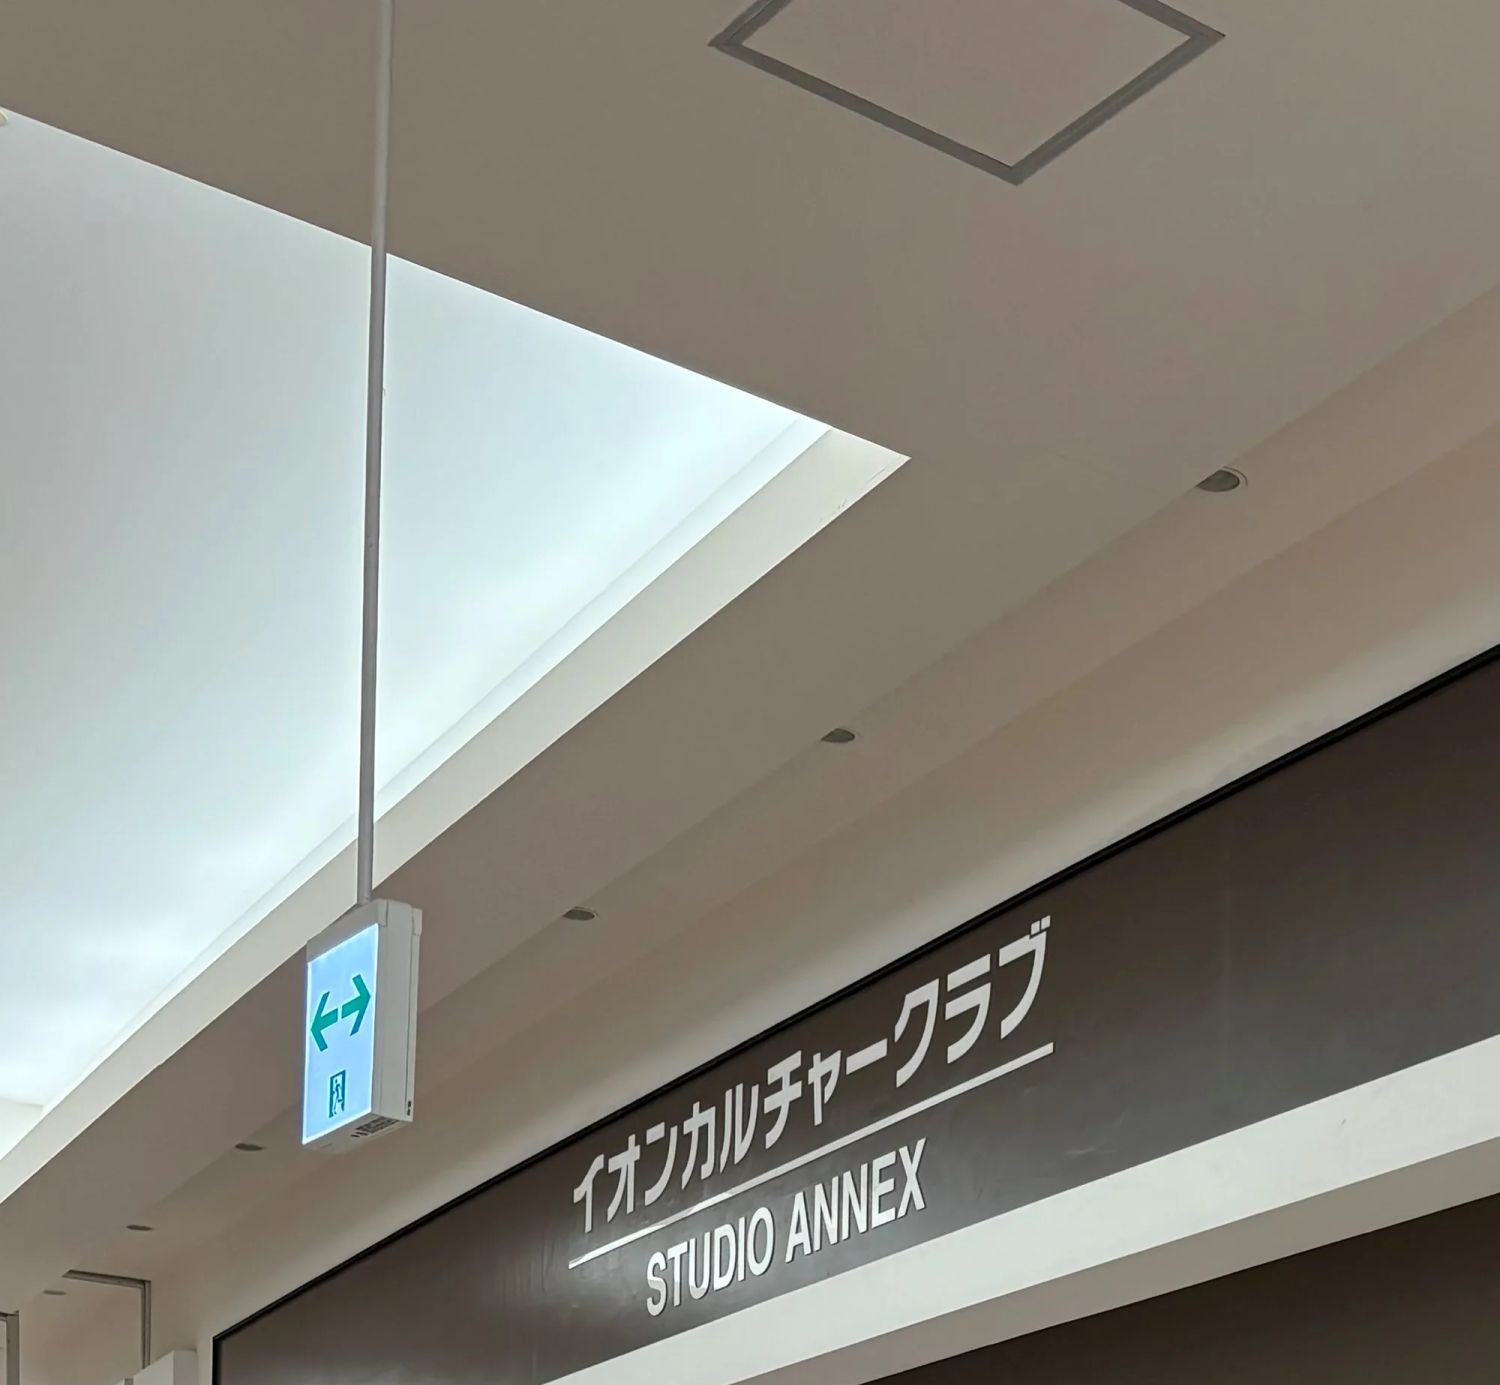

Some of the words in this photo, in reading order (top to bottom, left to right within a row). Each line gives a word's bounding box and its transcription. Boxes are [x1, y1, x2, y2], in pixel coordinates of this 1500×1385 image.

[573, 915, 1051, 1233] イオンカルチャークラブ
[646, 1206, 775, 1317] STUDIO
[785, 1138, 928, 1264] ANNEX
